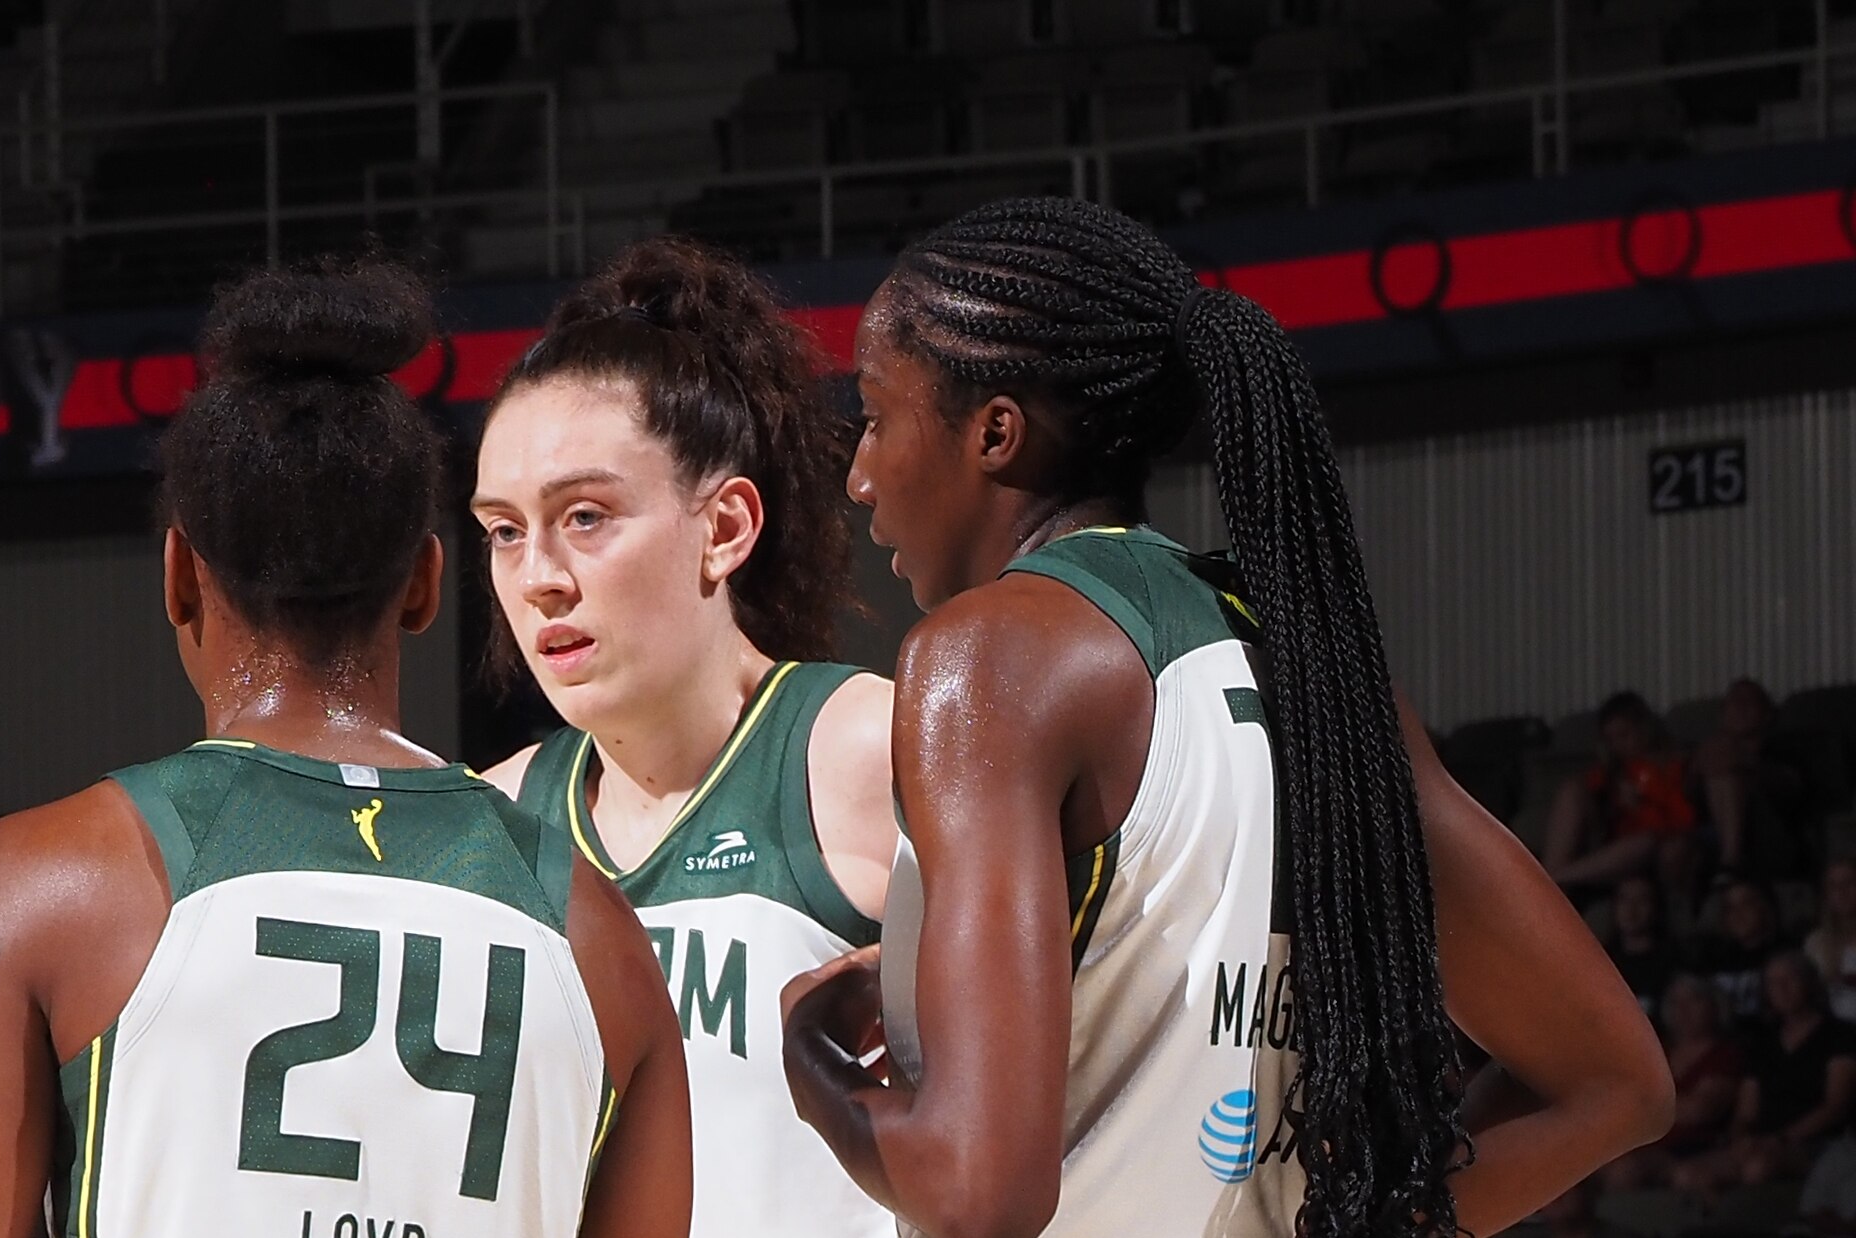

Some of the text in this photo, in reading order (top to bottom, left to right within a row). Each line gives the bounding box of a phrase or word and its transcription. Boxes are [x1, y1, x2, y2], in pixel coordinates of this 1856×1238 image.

[1653, 448, 1744, 508] 215
[684, 850, 756, 871] SYMETRA
[1210, 961, 1297, 1052] MAG
[238, 916, 526, 1202] 24
